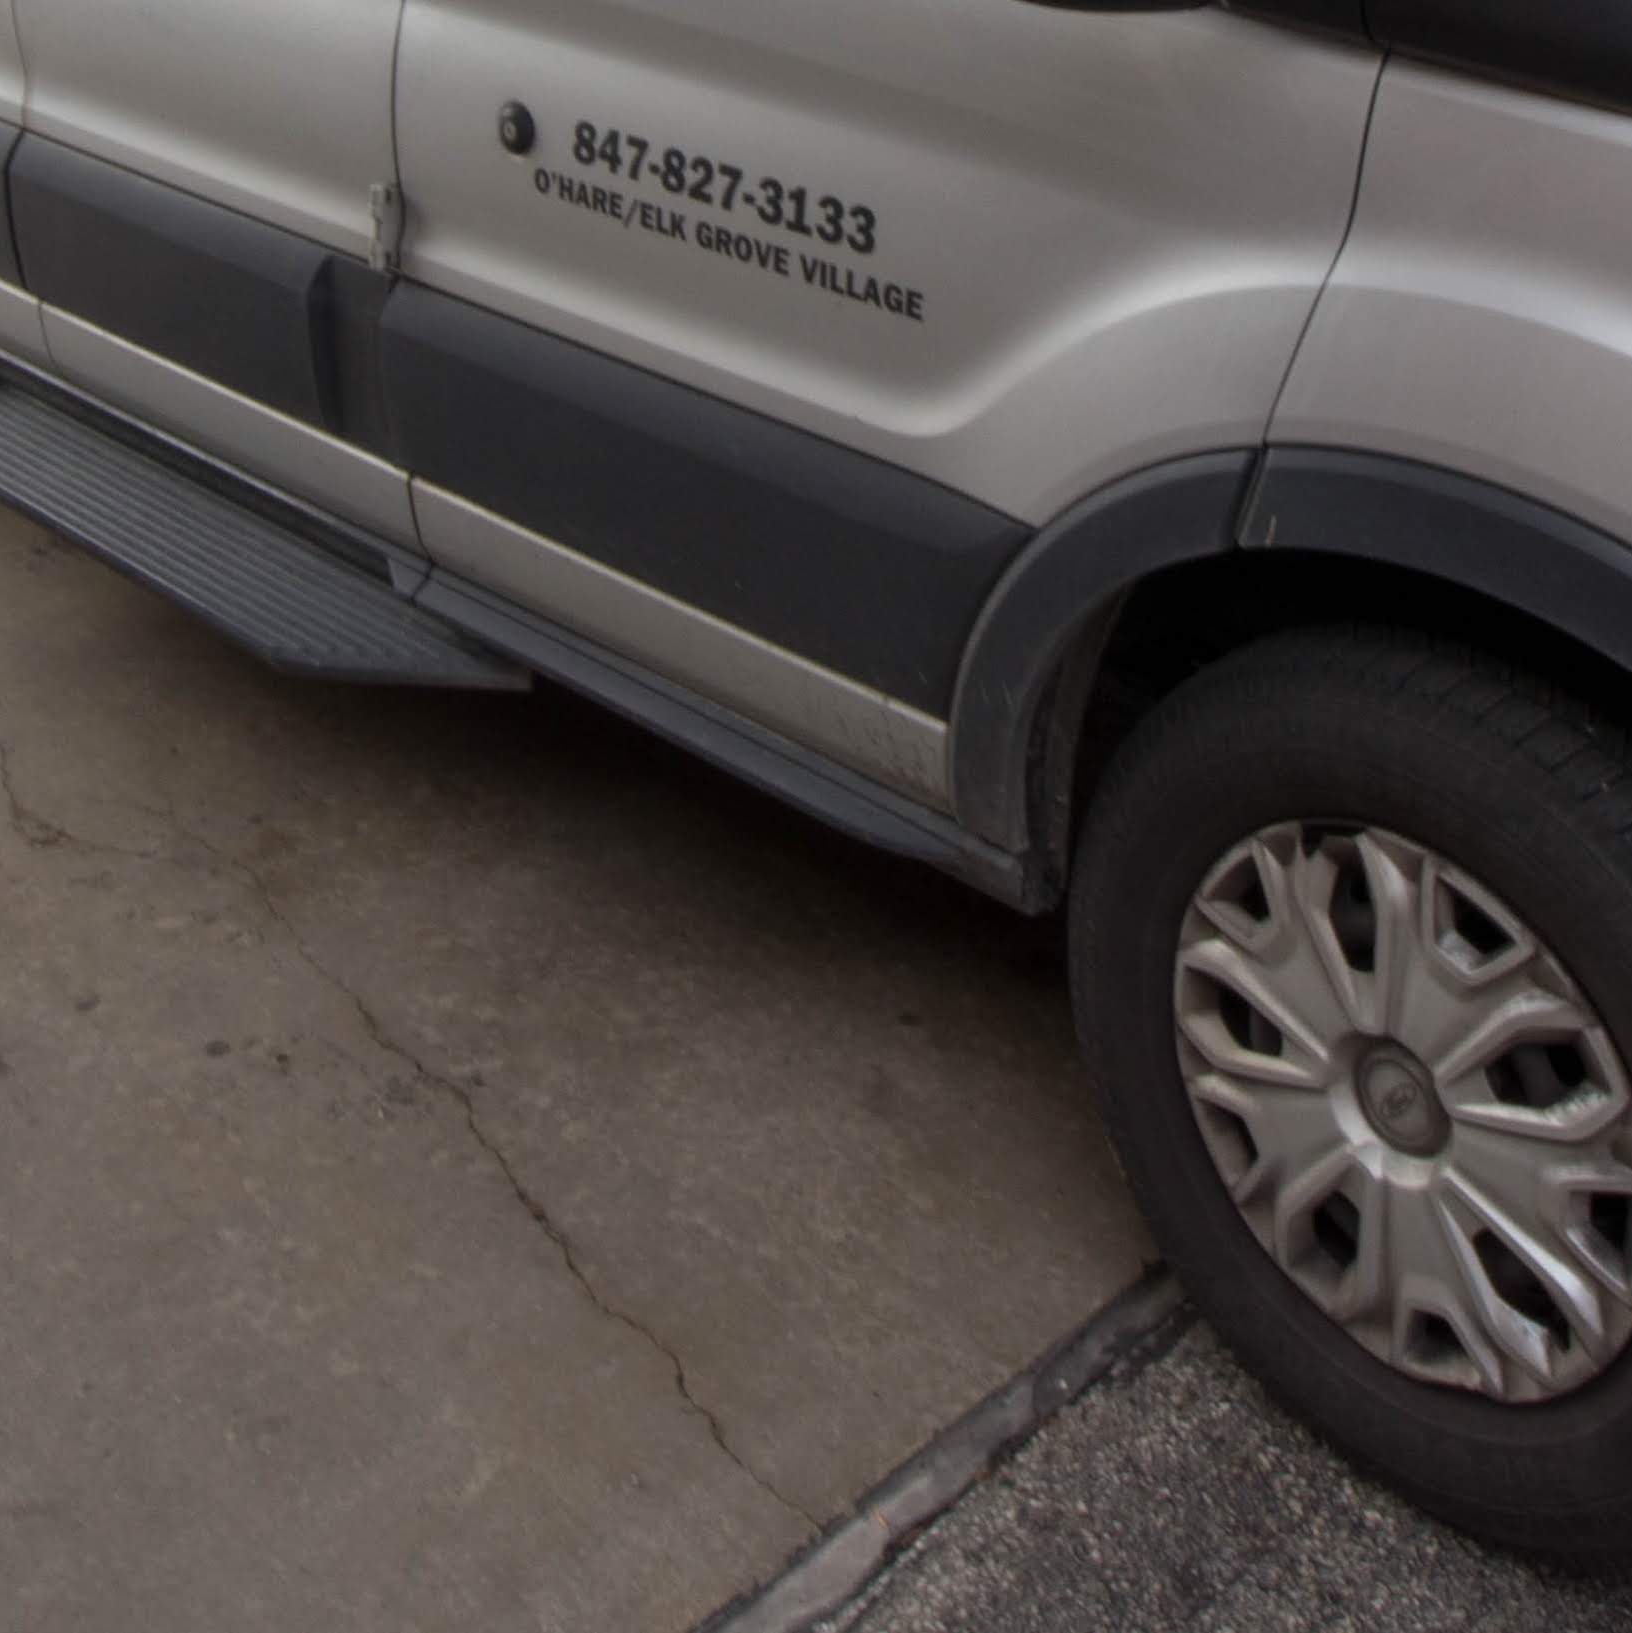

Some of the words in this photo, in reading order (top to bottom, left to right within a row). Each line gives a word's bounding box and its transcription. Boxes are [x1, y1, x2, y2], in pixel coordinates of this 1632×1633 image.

[534, 167, 687, 241] O'HARE/ELK
[695, 220, 791, 276] GROVE
[799, 253, 925, 322] VILLAGE
[572, 120, 878, 255] 847-827-3133
